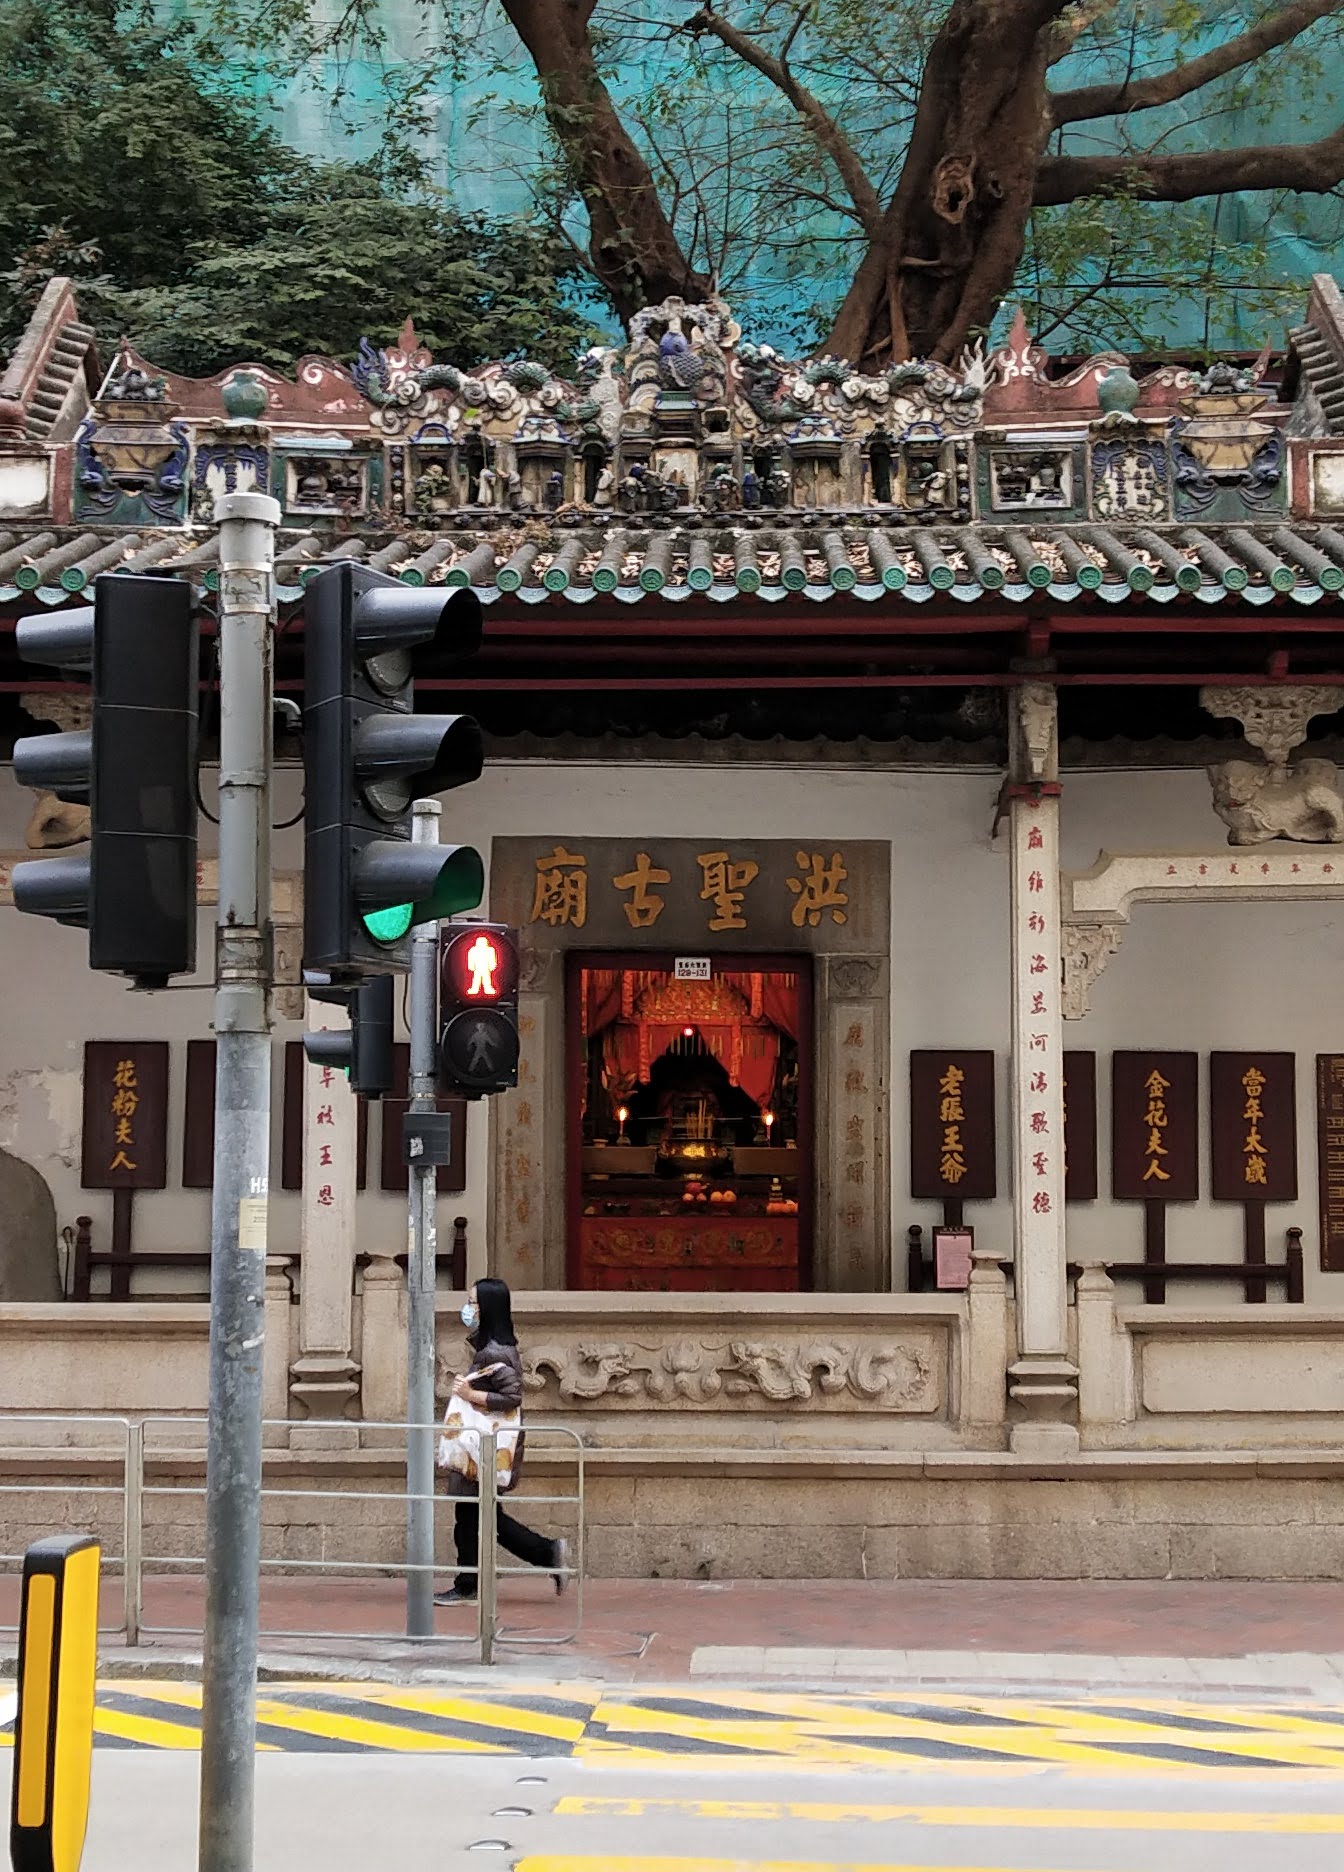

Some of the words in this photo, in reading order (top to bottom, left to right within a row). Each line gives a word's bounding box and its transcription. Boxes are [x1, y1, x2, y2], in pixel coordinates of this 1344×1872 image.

[529, 846, 850, 932] 洪聖古廟
[109, 1060, 139, 1171] 花粉夫人
[938, 1064, 968, 1184] 老張王爺
[1142, 1070, 1171, 1182] 金花夫人
